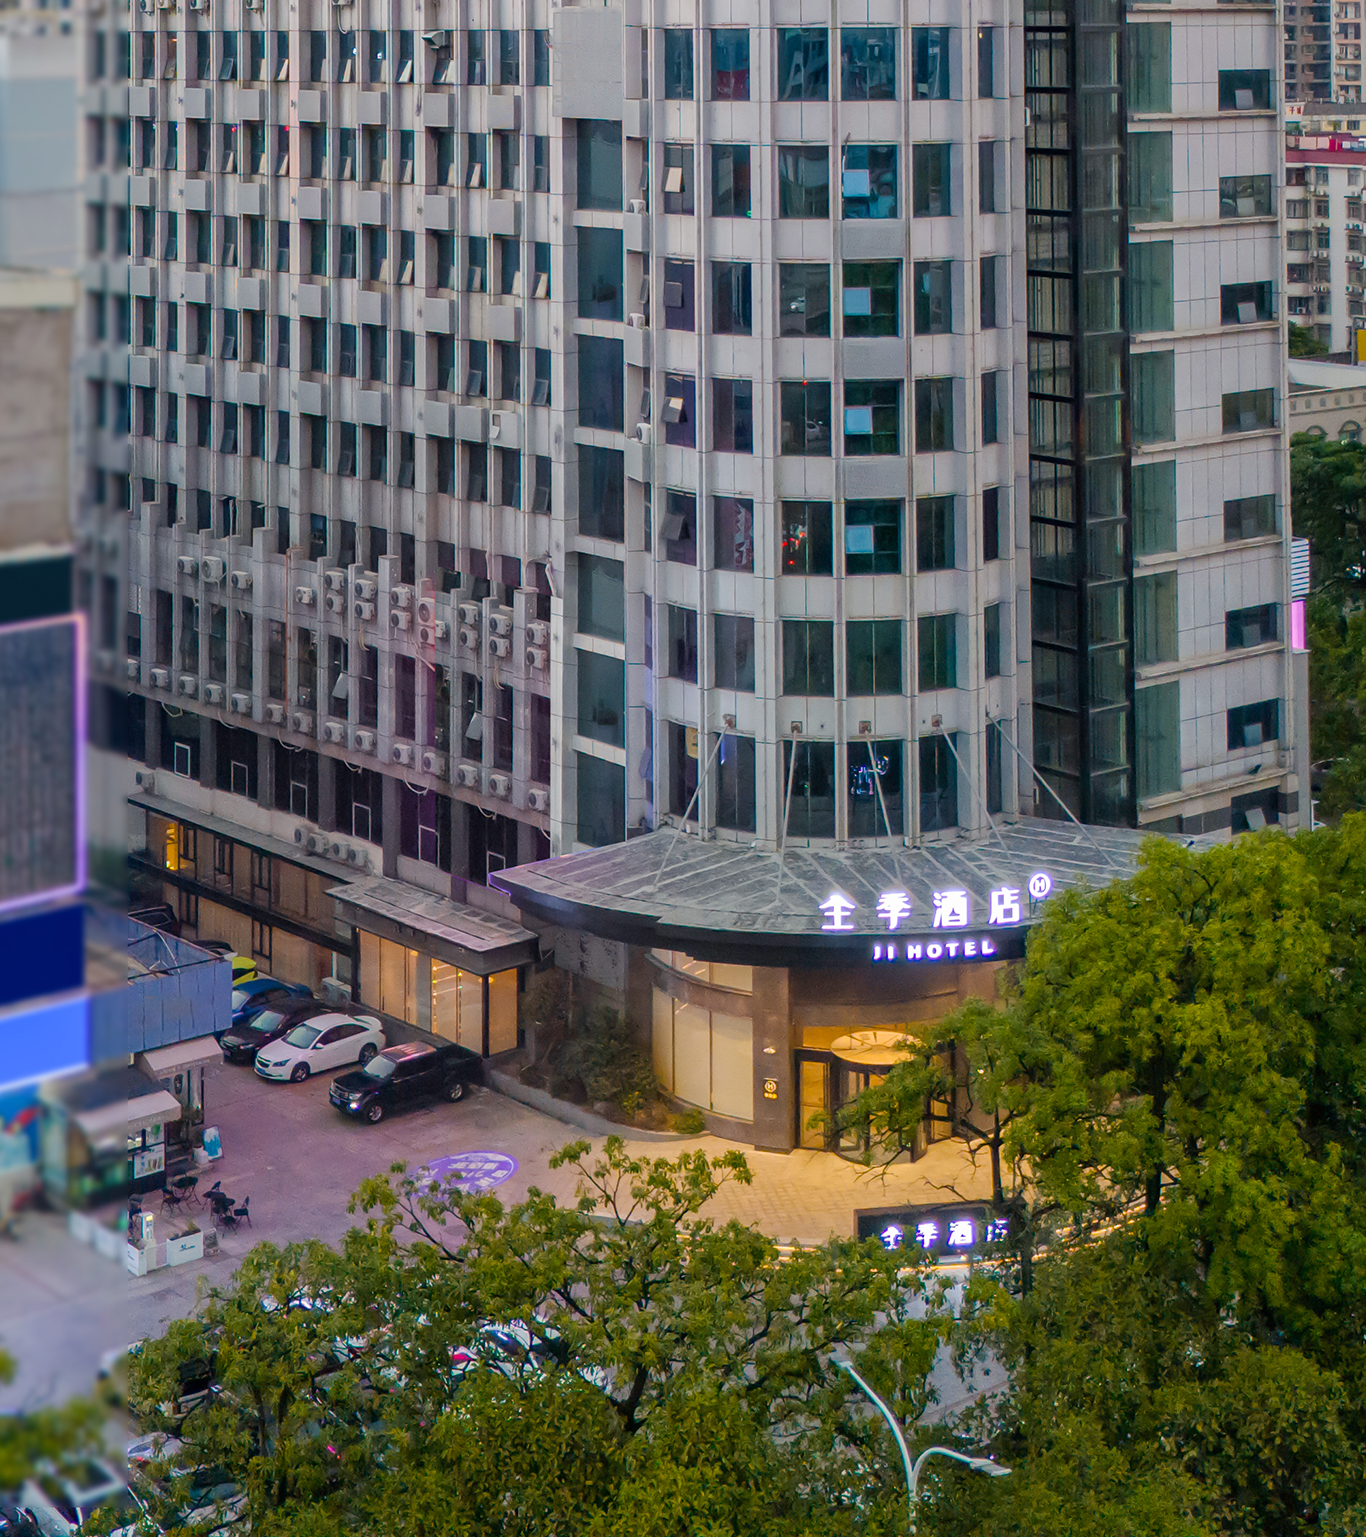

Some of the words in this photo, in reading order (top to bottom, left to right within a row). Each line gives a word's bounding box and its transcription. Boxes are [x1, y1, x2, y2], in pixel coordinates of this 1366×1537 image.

[818, 885, 1021, 931] 全季酒店
[873, 944, 895, 961] JI
[906, 940, 997, 960] HOTEL
